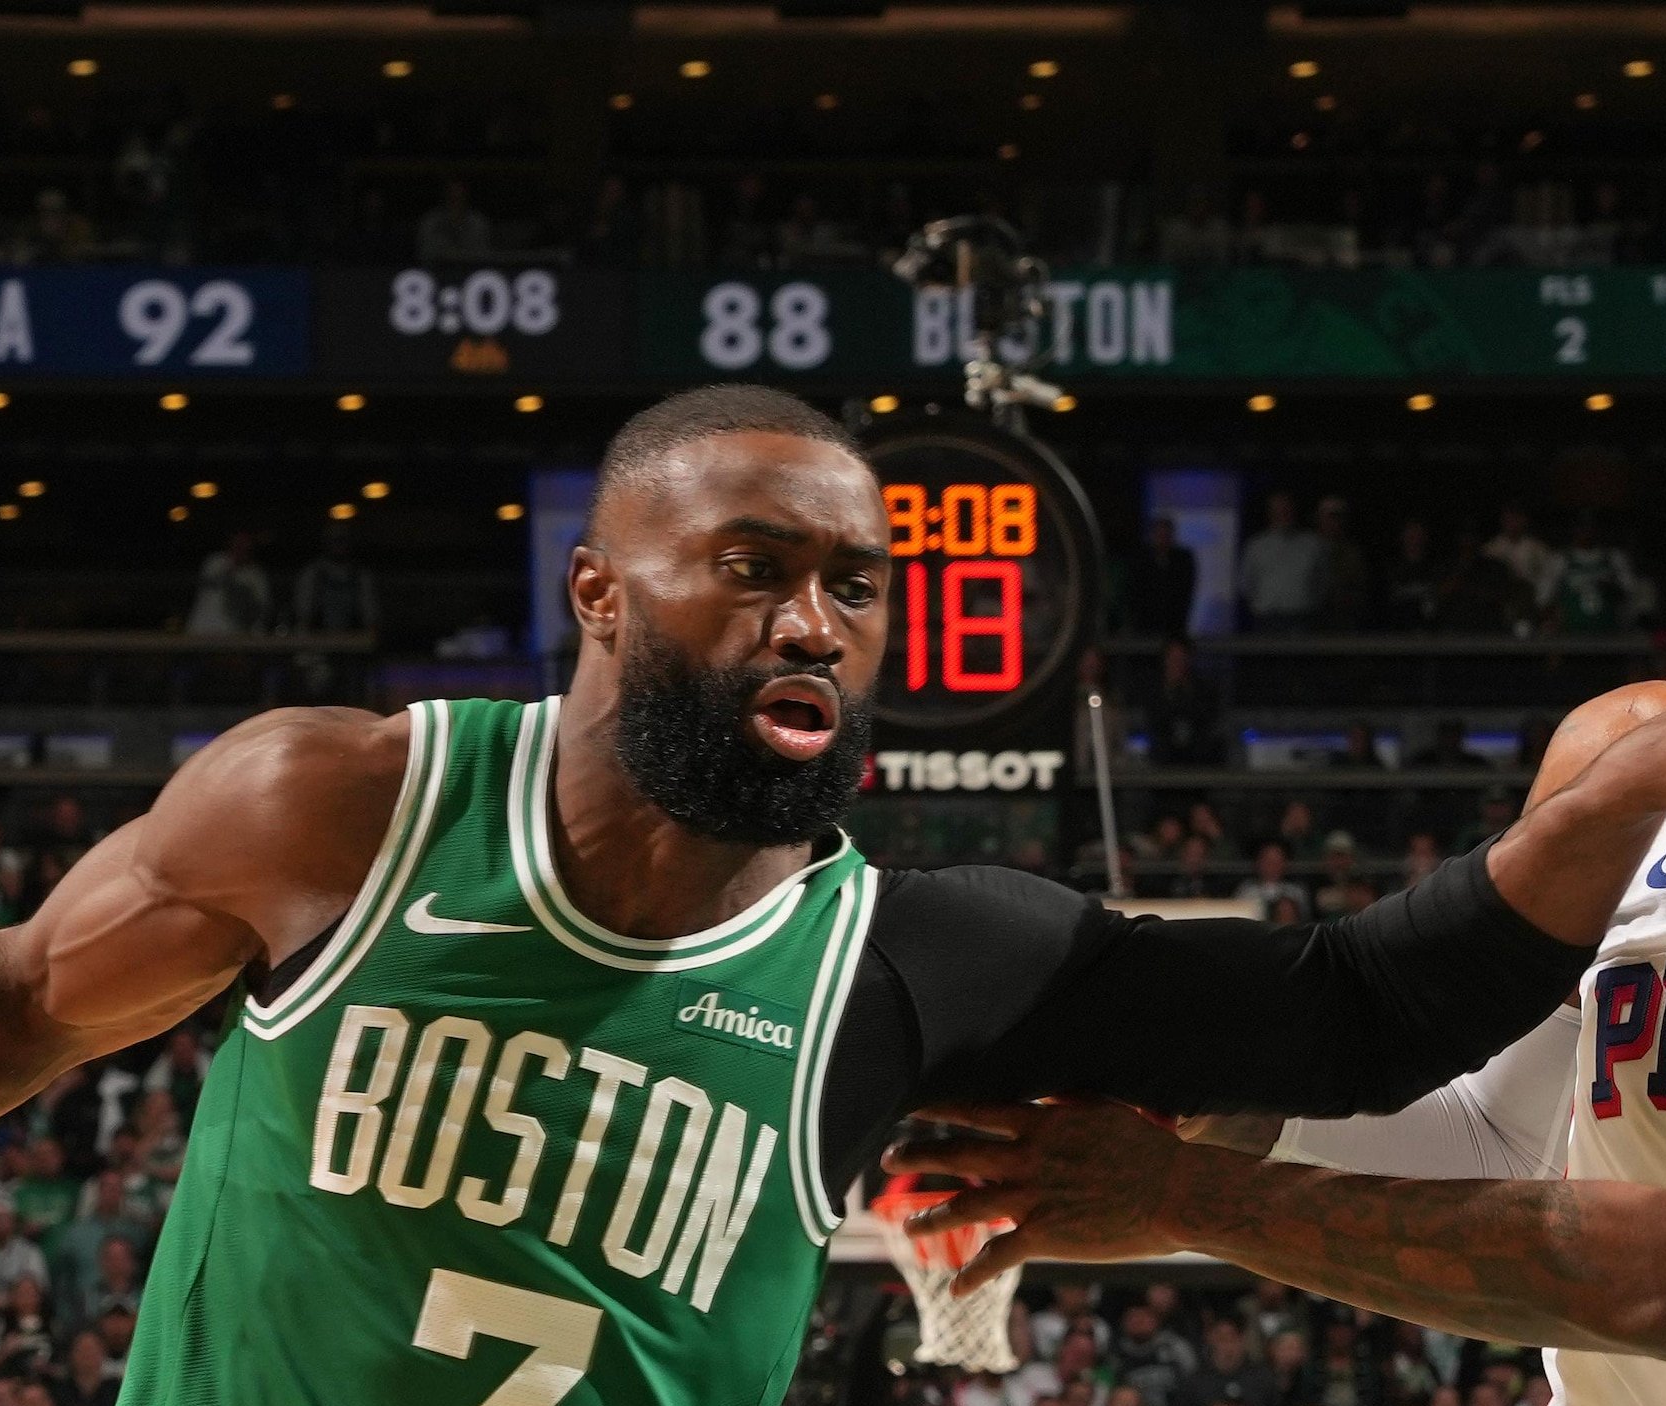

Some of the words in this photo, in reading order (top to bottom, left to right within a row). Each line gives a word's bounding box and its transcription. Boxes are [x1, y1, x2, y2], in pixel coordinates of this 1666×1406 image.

[119, 280, 255, 366] 92
[390, 269, 560, 335] 8:08
[700, 282, 832, 370] 88
[1554, 317, 1587, 364] 2
[907, 560, 1024, 693] 18
[877, 750, 1065, 790] TISSOT
[678, 992, 794, 1049] Amica
[309, 1005, 779, 1314] BOSTON
